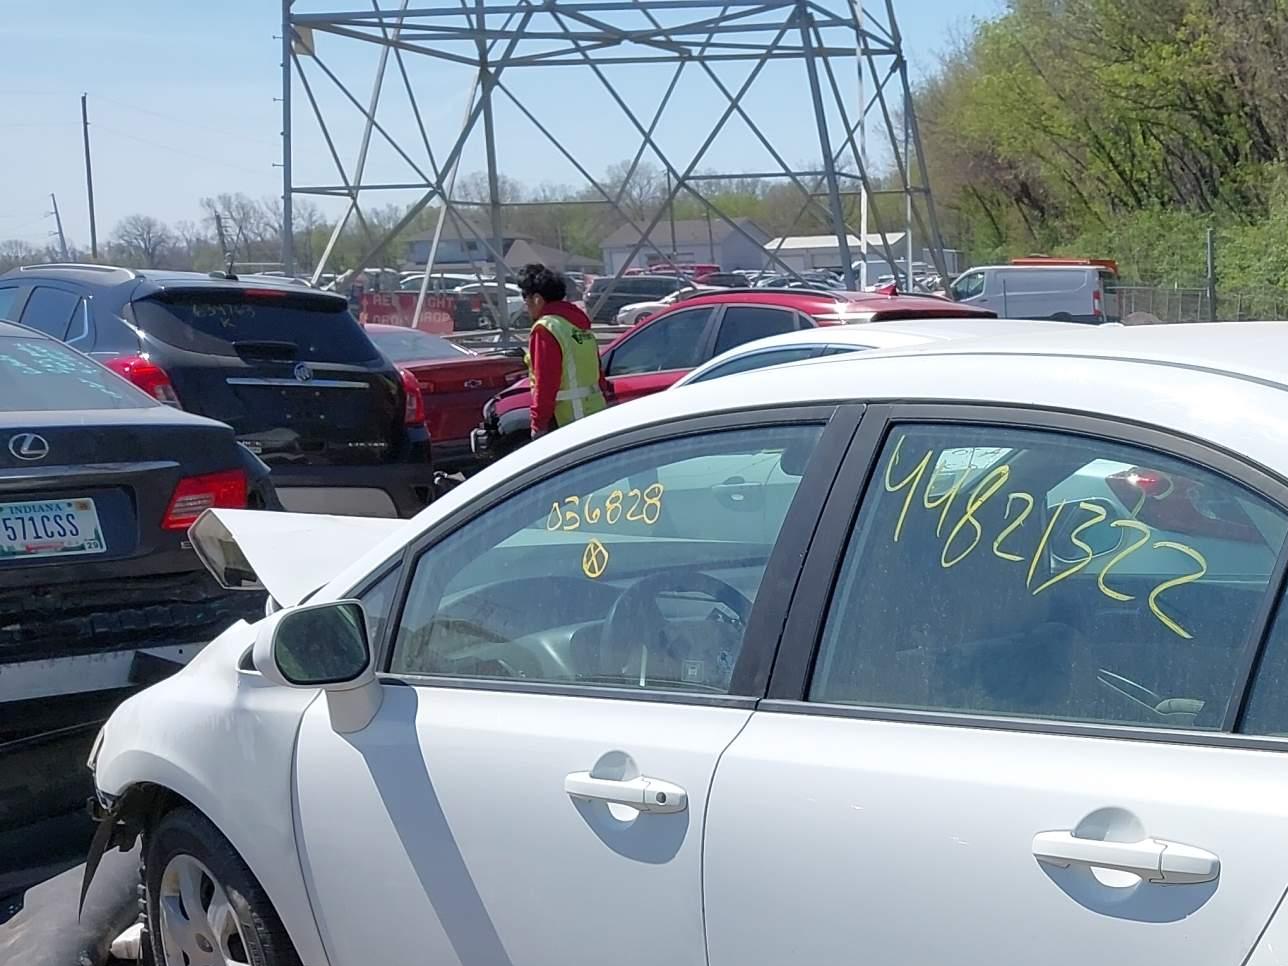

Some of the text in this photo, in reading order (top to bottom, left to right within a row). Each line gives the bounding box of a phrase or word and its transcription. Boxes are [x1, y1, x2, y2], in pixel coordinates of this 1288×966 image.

[8, 503, 63, 514] INDIANA
[546, 483, 663, 531] 036828
[2, 513, 79, 541] 571CSS
[886, 434, 1208, 640] 44821322
